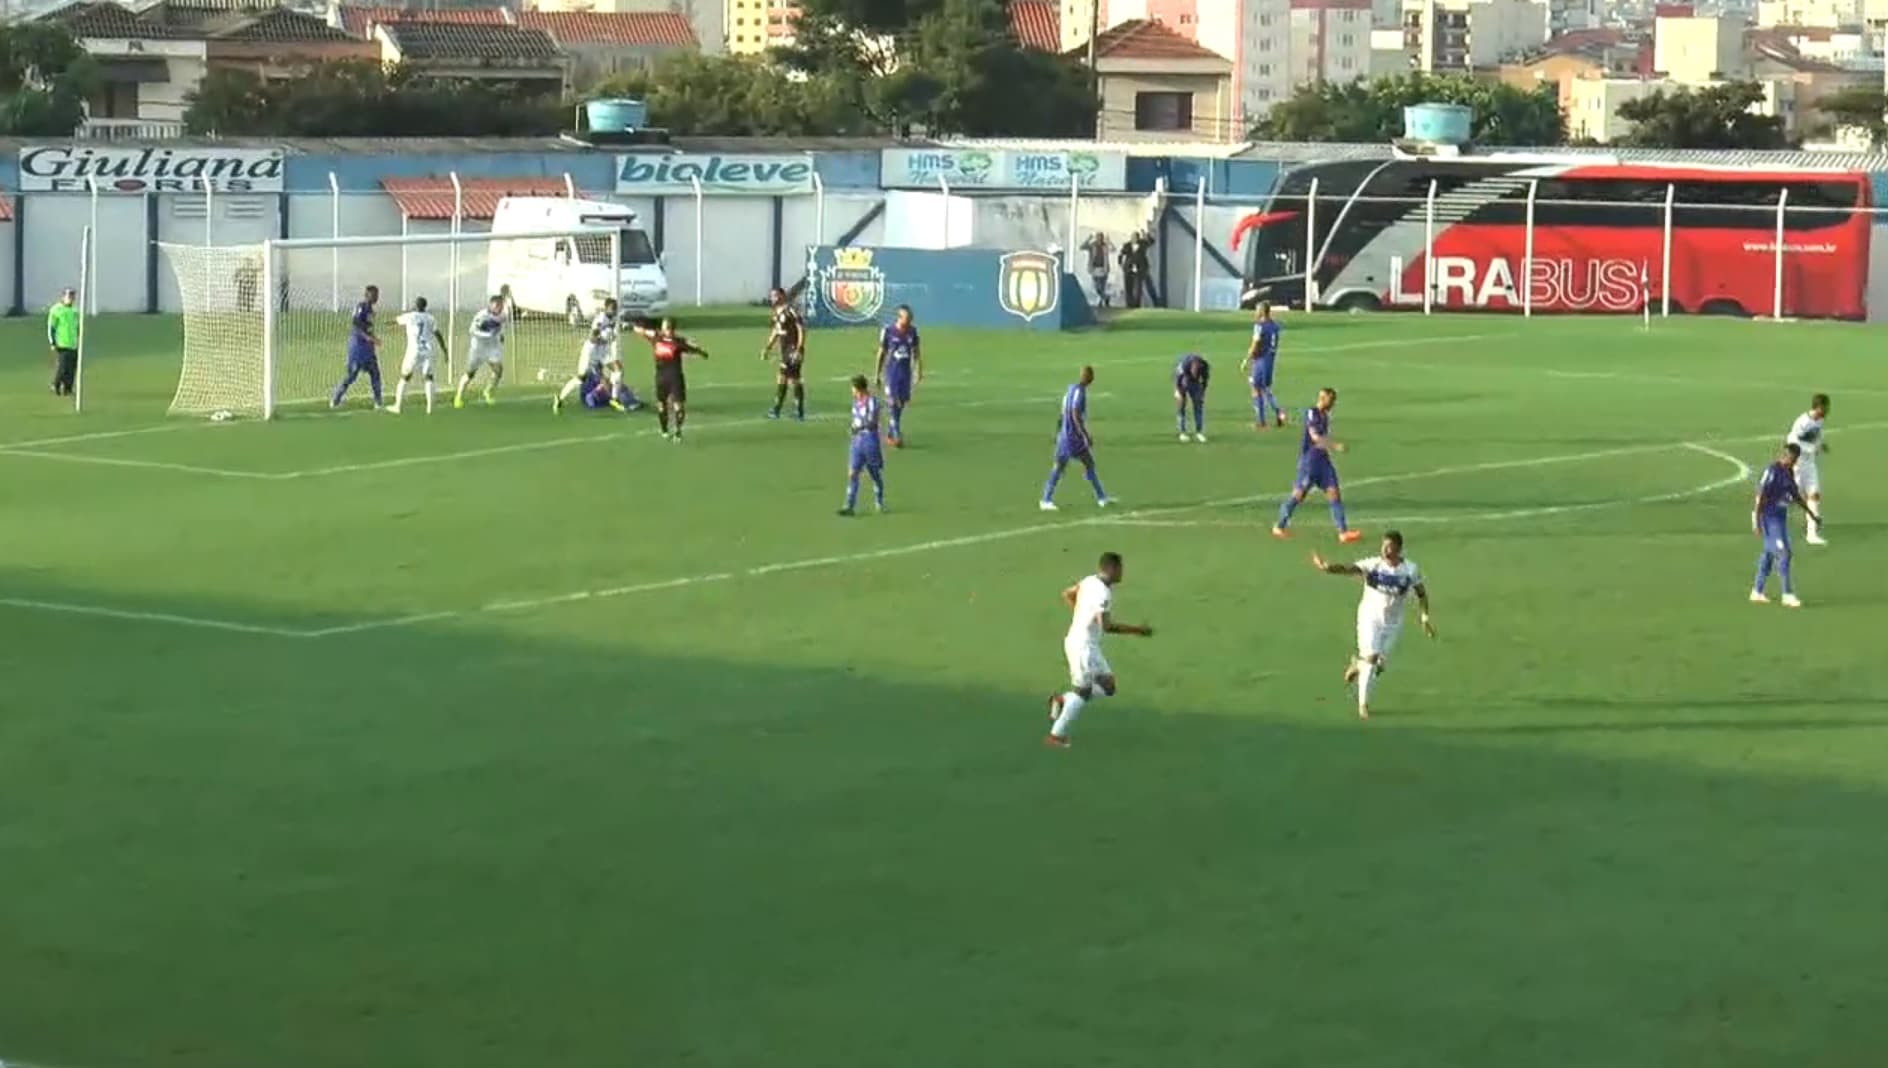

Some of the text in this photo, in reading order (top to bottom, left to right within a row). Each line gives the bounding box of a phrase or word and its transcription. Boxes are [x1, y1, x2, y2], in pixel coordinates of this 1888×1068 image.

[620, 156, 810, 182] bioleve
[1016, 155, 1062, 170] HMS
[911, 170, 989, 184] Naural
